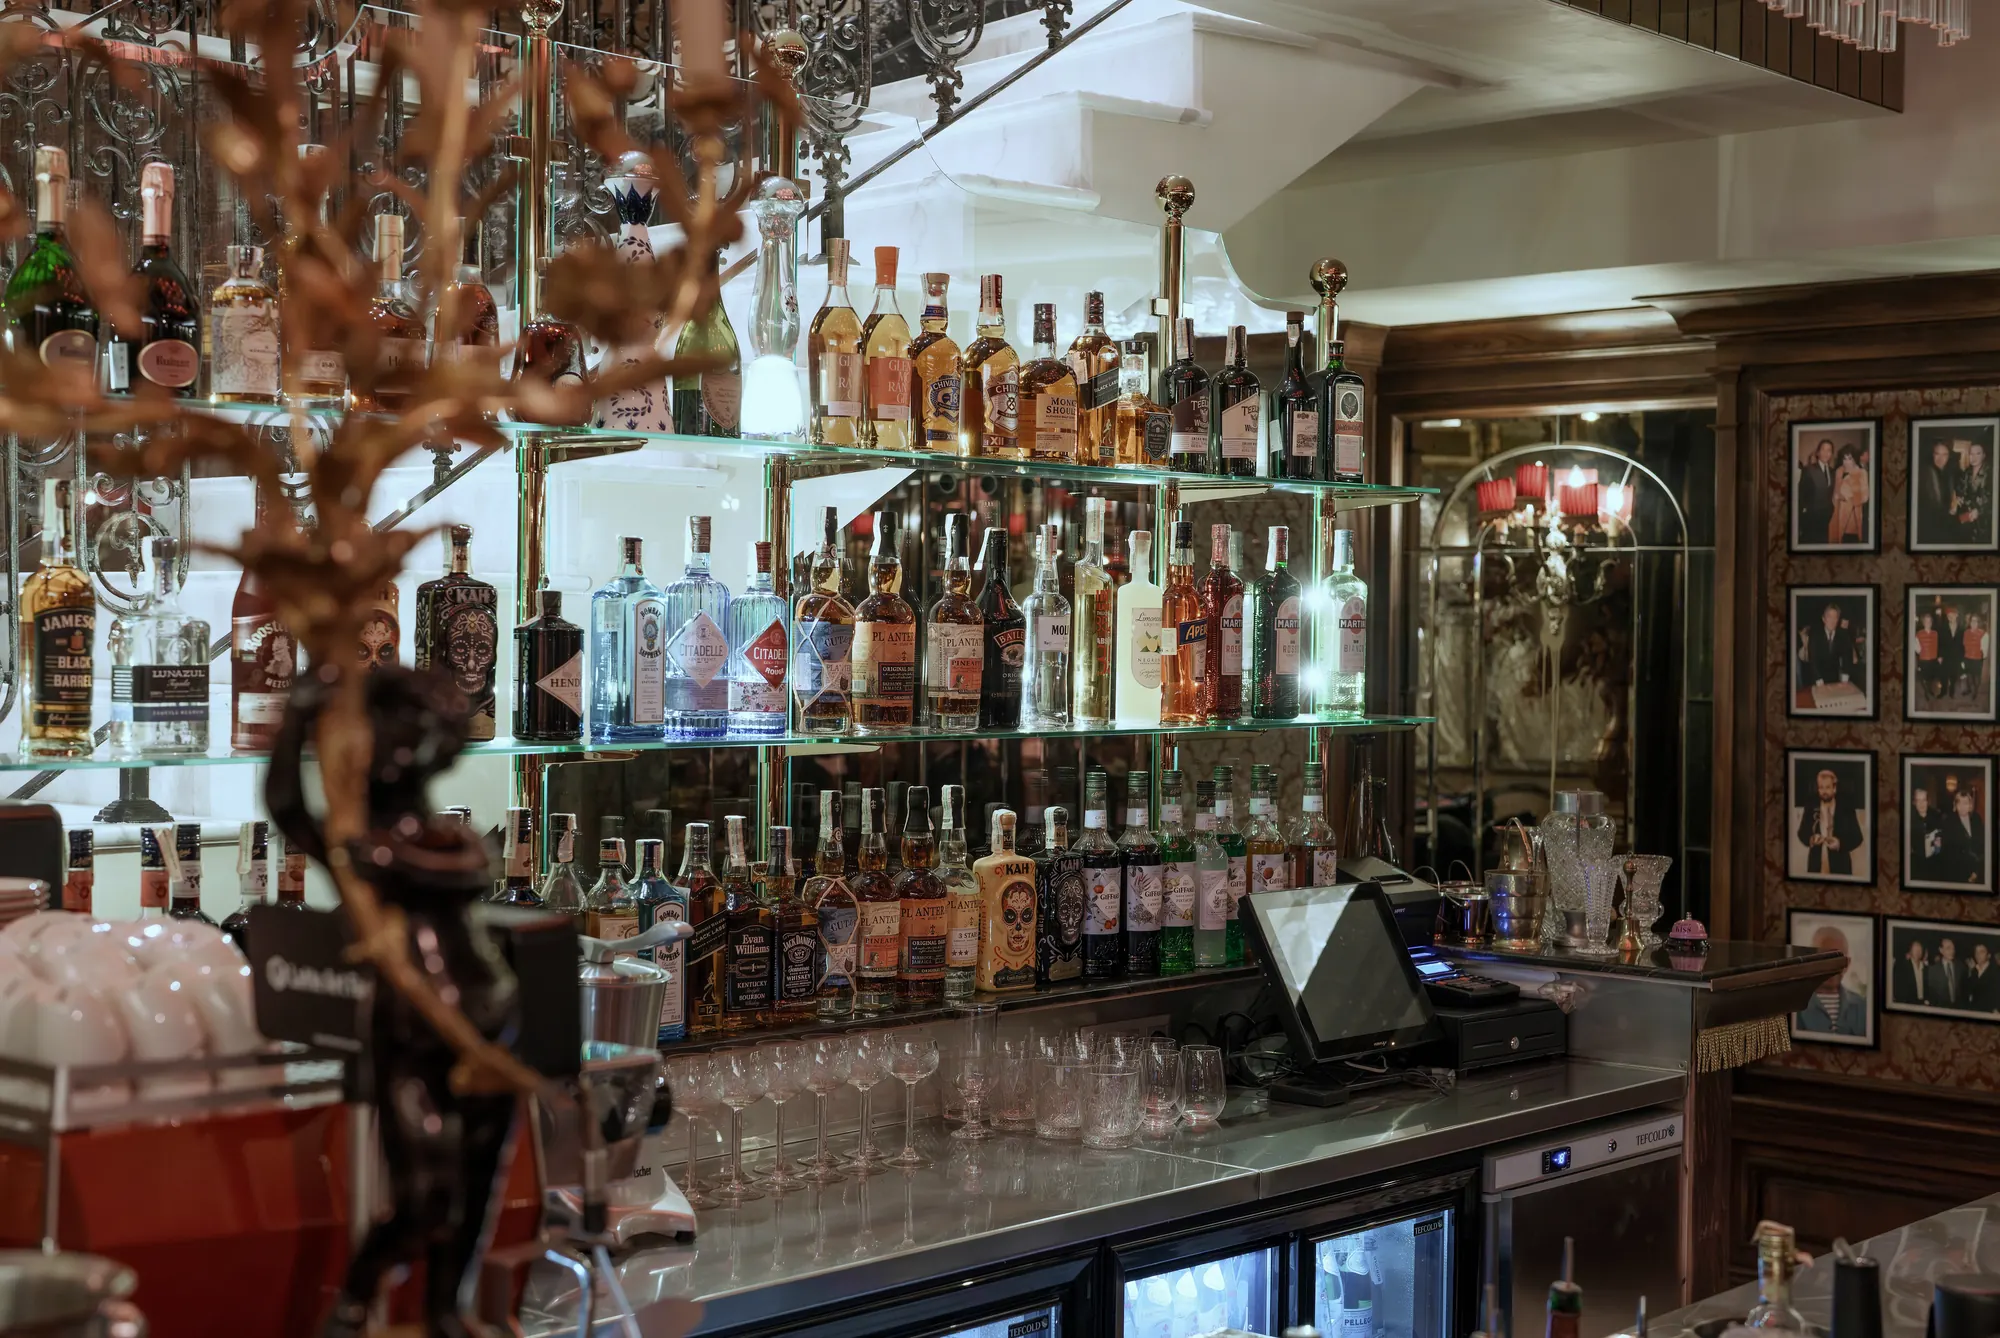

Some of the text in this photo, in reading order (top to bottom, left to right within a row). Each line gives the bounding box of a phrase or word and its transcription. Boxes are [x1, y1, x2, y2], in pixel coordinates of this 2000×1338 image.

[990, 436, 1004, 446] XII
[457, 587, 489, 603] KAH
[640, 607, 662, 619] BOMBAY
[639, 648, 662, 661] SAPPHIRE
[679, 645, 724, 657] CITADELLE
[152, 670, 205, 678] LUNAZUL
[54, 674, 92, 688] BARREL
[1005, 863, 1029, 875] KAH
[1060, 859, 1079, 872] KAH
[659, 910, 681, 922] BOMBAY
[691, 927, 711, 940] BLACK
[742, 934, 764, 945] Evan
[735, 944, 770, 955] Williams
[782, 937, 796, 953] JACK
[658, 948, 681, 962] SAPPHIRE
[786, 973, 811, 982] WHISKEY
[737, 980, 768, 989] KENTUCKY
[739, 993, 766, 1002] BOURBON
[1636, 1128, 1668, 1146] TEFCOLD
[1414, 1222, 1438, 1234] TEFCOLD
[1009, 1321, 1041, 1338] TEFCOLD
